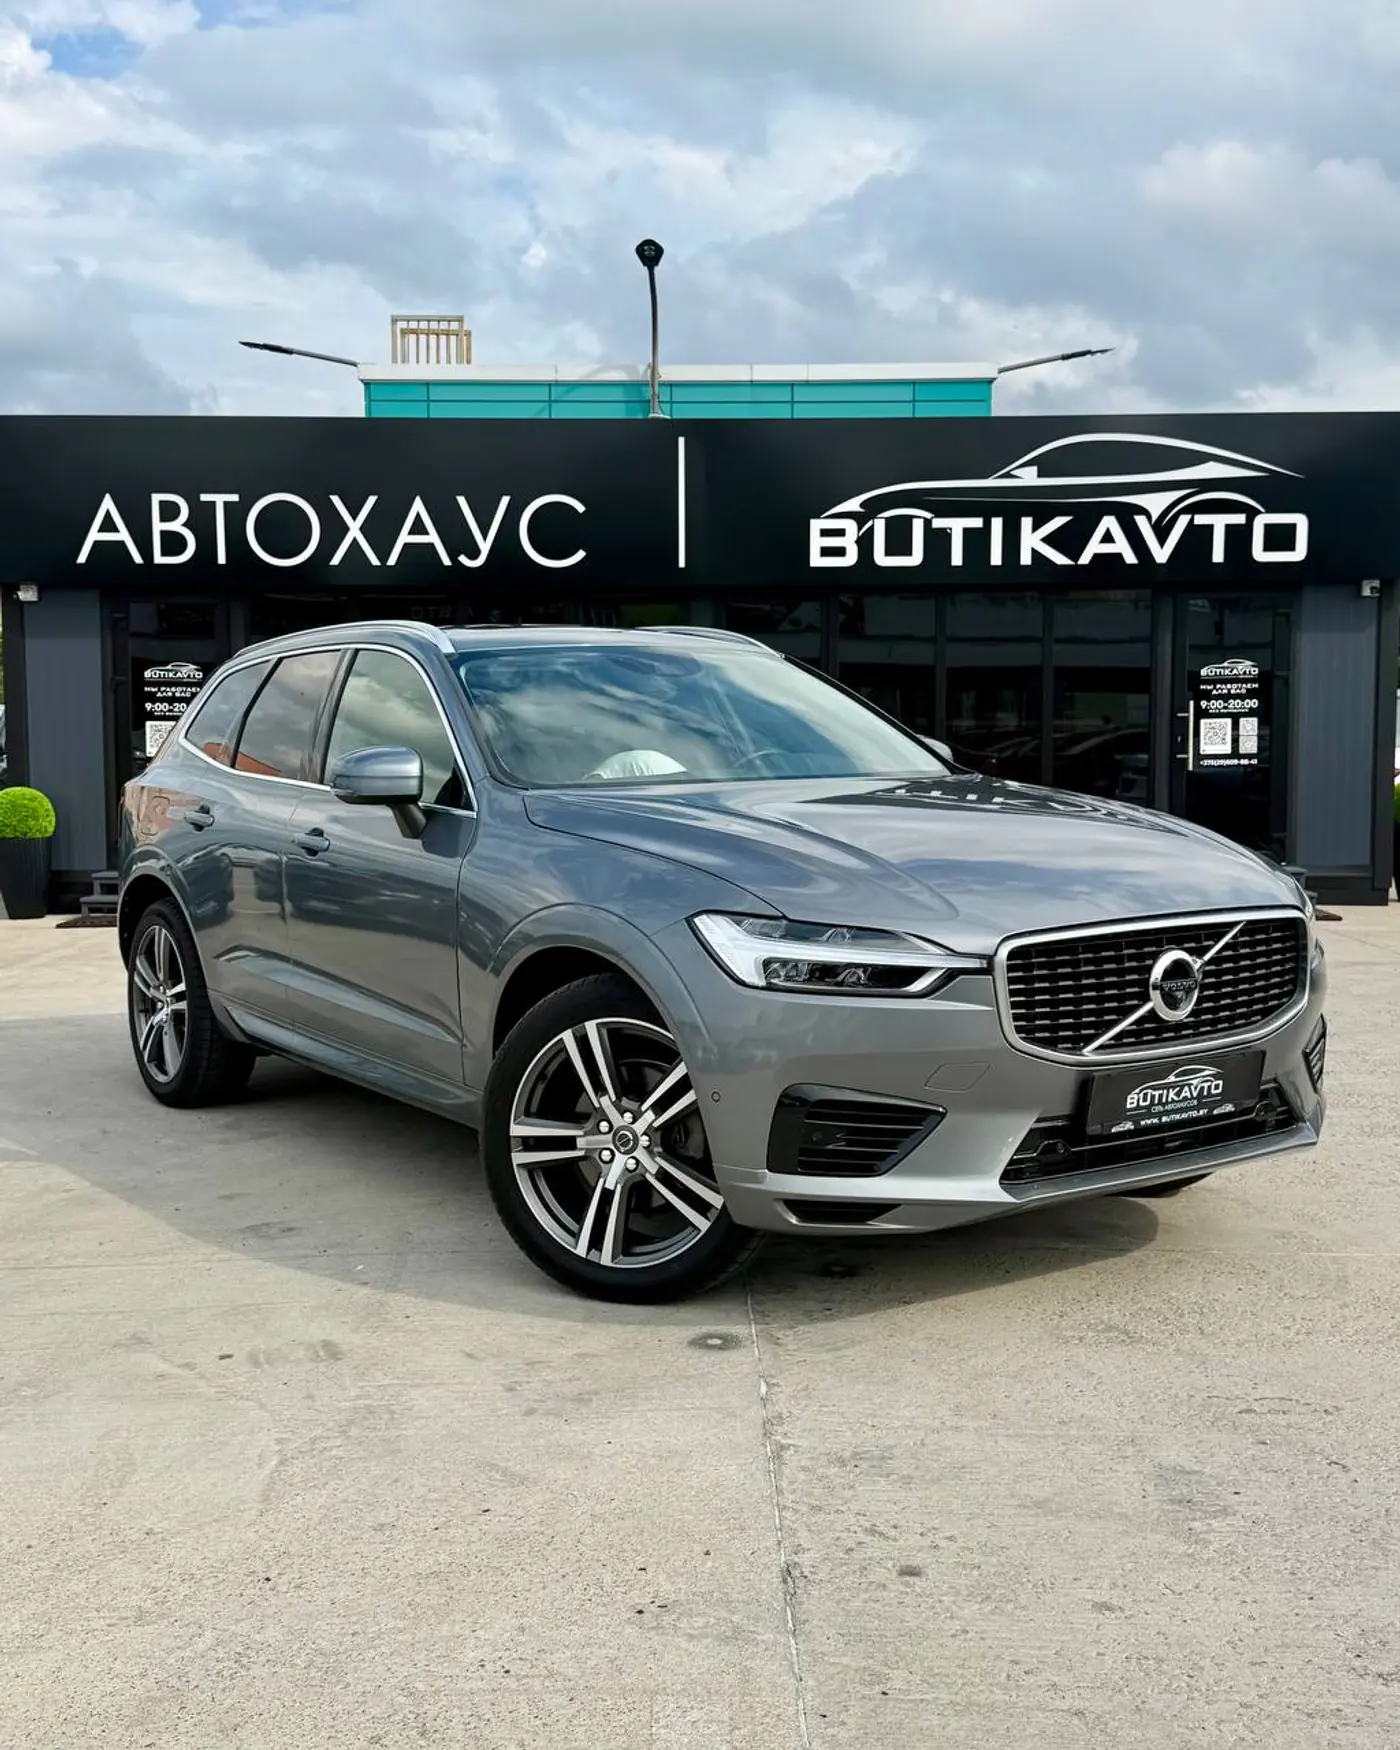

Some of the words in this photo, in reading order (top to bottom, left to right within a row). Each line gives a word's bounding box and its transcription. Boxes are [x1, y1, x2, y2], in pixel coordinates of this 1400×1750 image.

[77, 493, 587, 567] АВТОХАУС
[810, 512, 1309, 567] BUTIKAVTO
[1200, 668, 1259, 676] BUTIKAVTO
[144, 702, 187, 711] 9:00-20
[1200, 699, 1259, 709] 9:00-20:00
[1126, 1080, 1223, 1109] BUTIKAVTO
